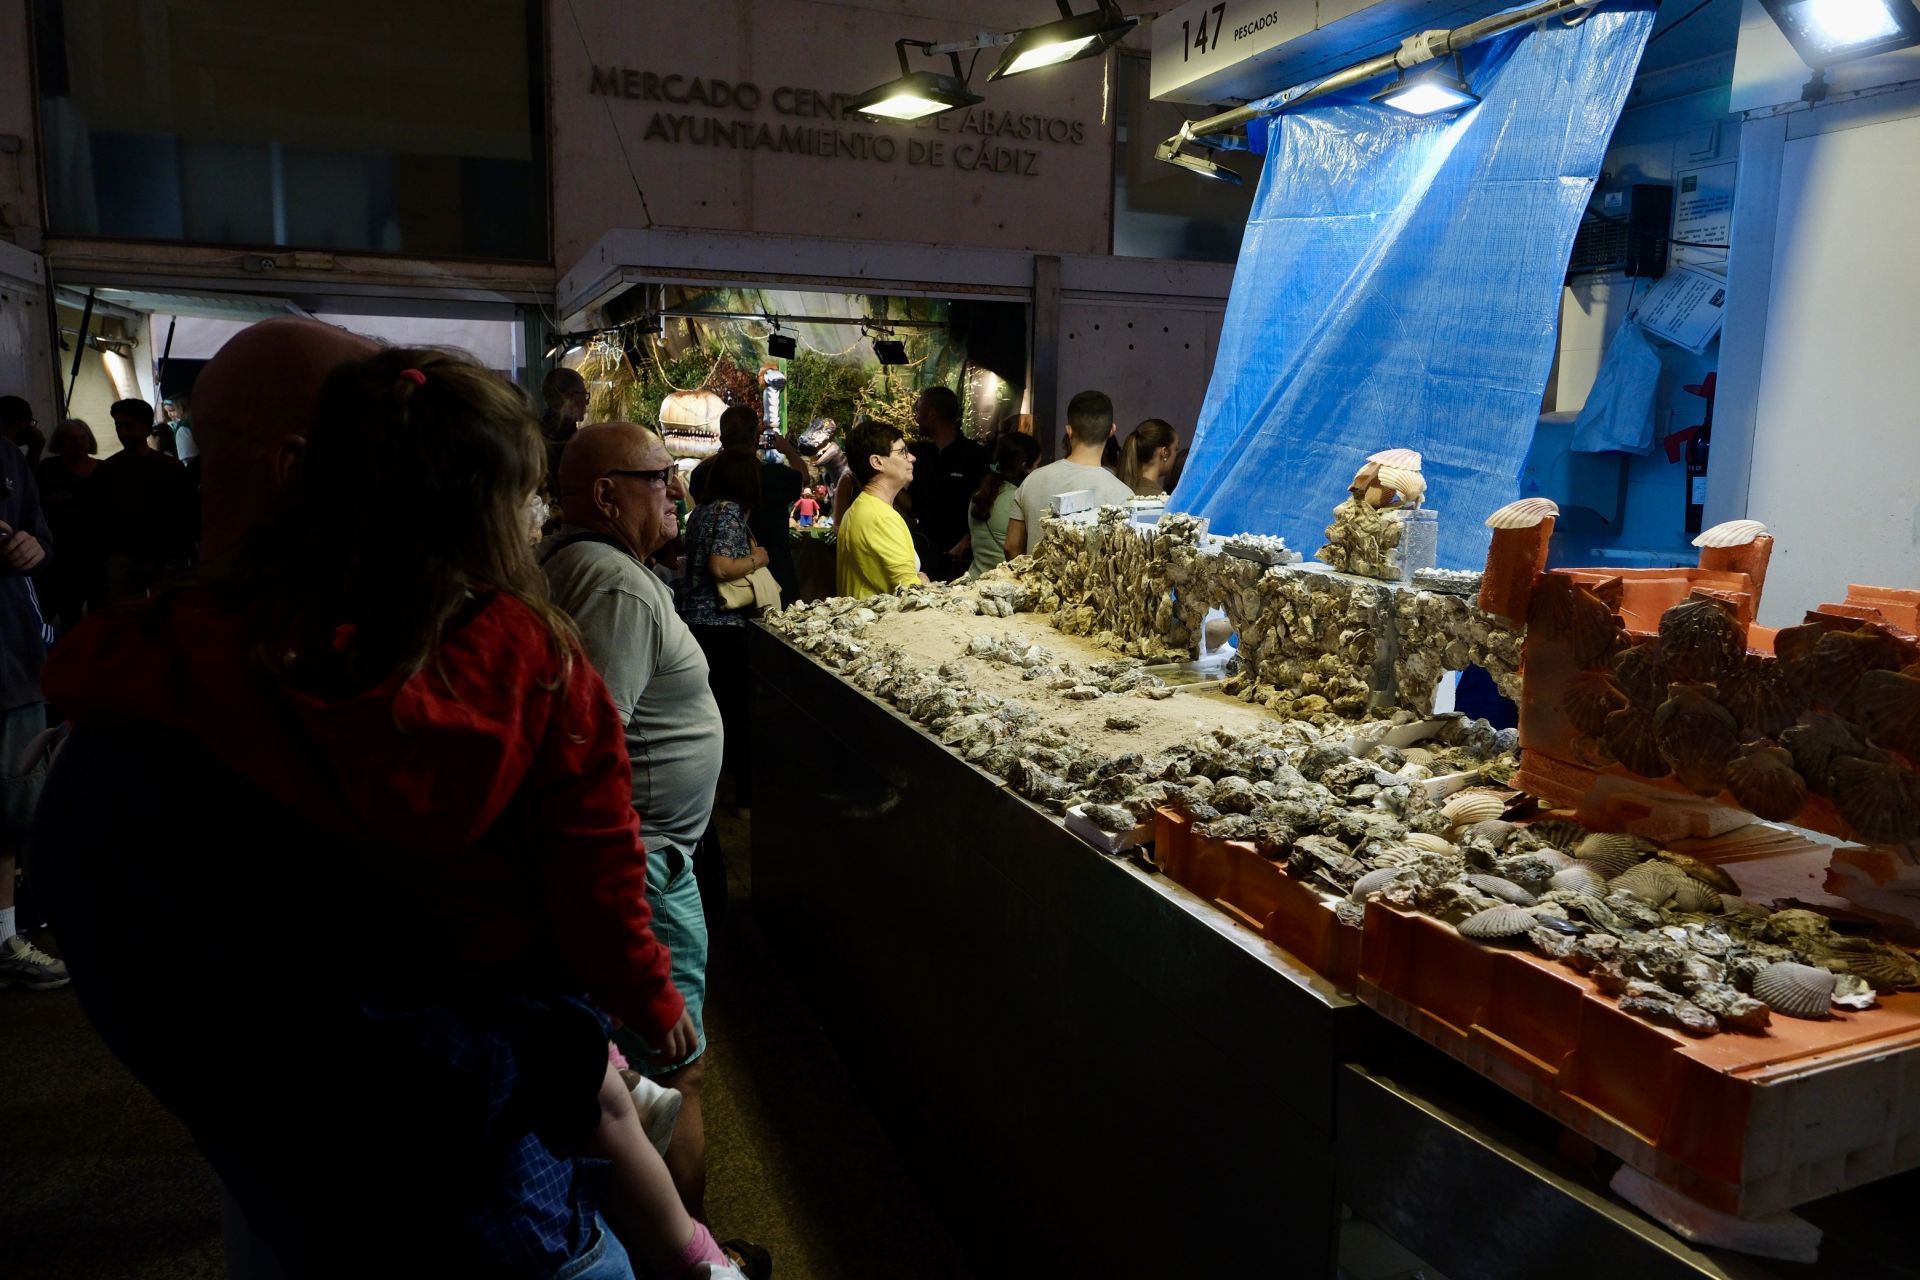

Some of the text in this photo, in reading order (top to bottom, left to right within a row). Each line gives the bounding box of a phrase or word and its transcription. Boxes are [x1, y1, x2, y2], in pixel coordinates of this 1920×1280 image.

[1182, 2, 1278, 62] 147 PESCADOS
[590, 64, 761, 111] MERCADO
[772, 86, 907, 128] CENT
[959, 107, 1086, 145] ABASTOS
[643, 111, 1040, 177] AYUNTAMIENTO DE CÁDIZ
